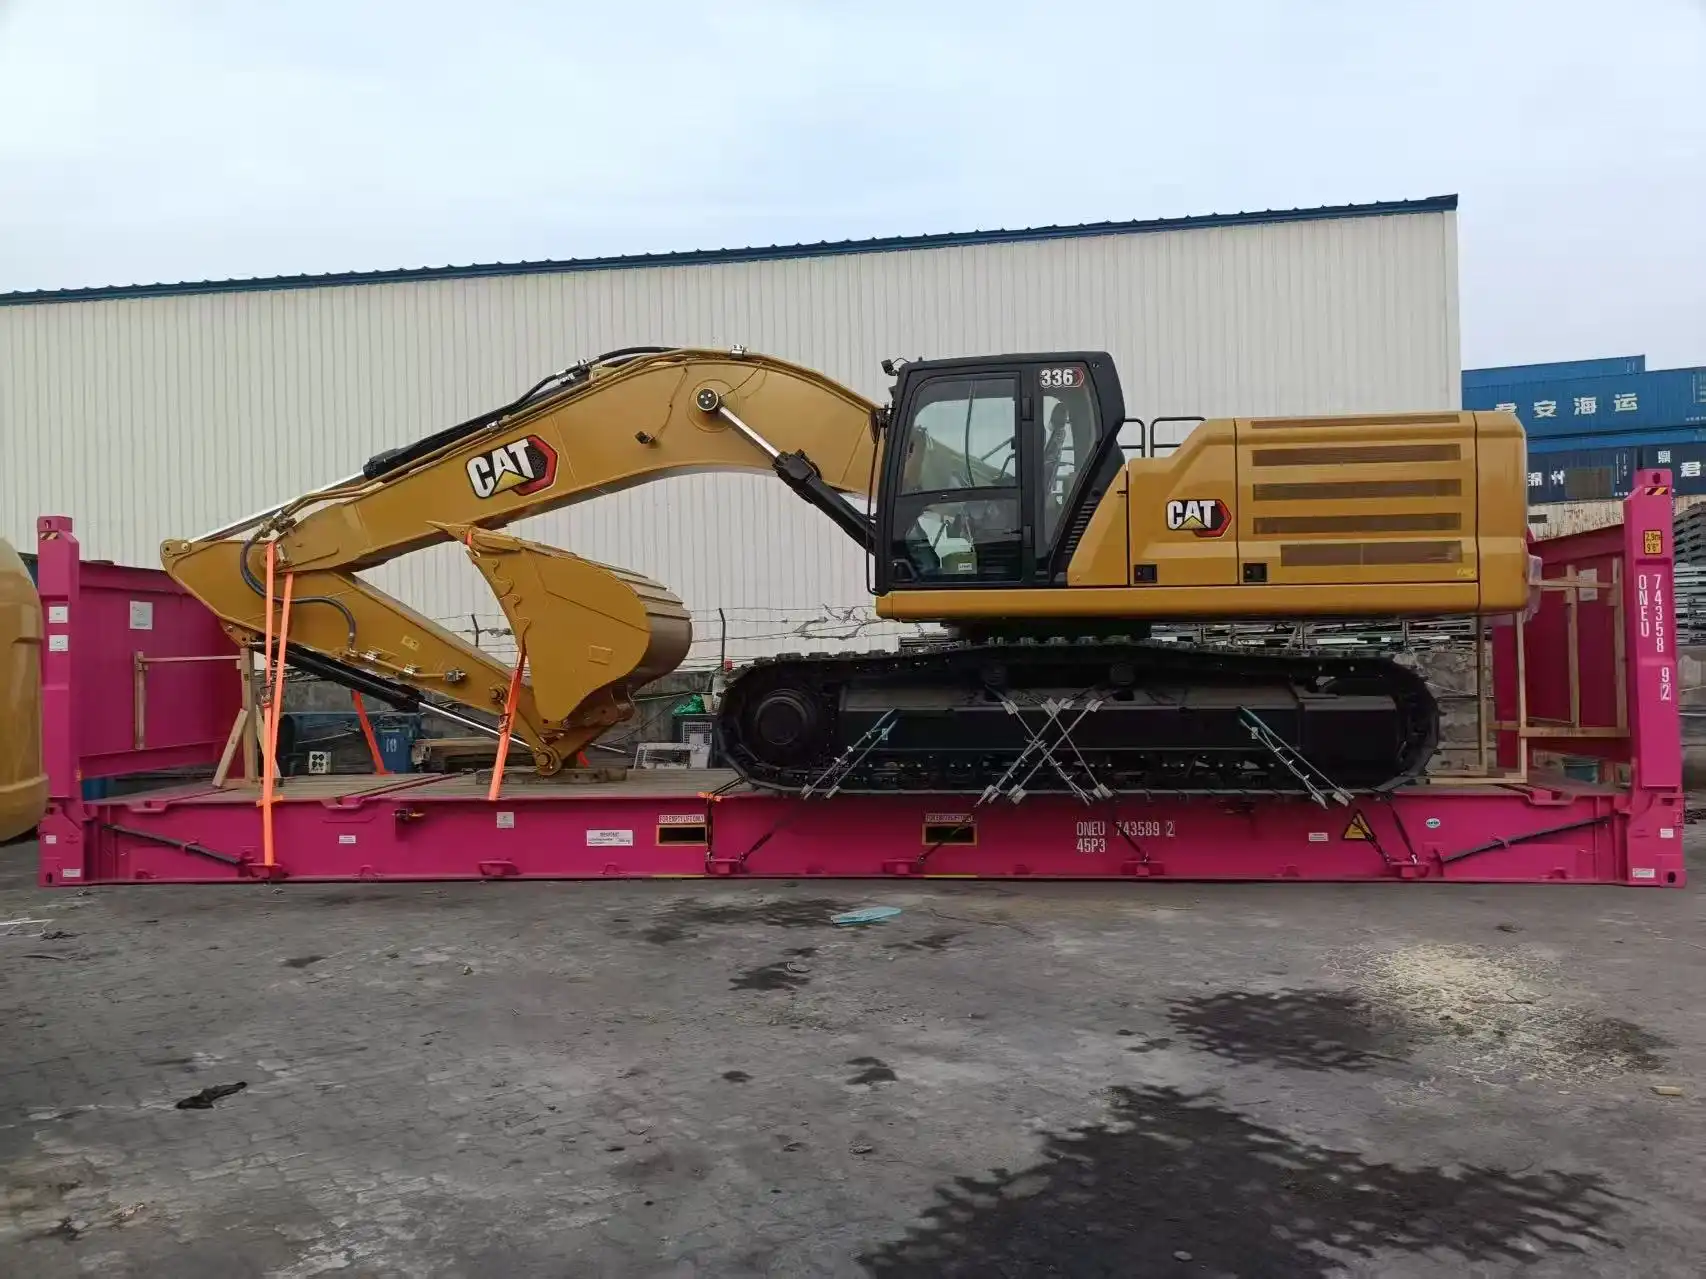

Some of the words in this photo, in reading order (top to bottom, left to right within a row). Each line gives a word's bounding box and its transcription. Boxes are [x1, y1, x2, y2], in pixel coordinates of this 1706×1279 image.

[1041, 369, 1073, 386] 336
[466, 438, 535, 498] CAT
[1167, 500, 1216, 530] CAT
[1638, 574, 1650, 638] ONEU
[1076, 821, 1106, 836] ONEU
[1116, 821, 1160, 836] 743589
[1076, 838, 1106, 853] 45P3
